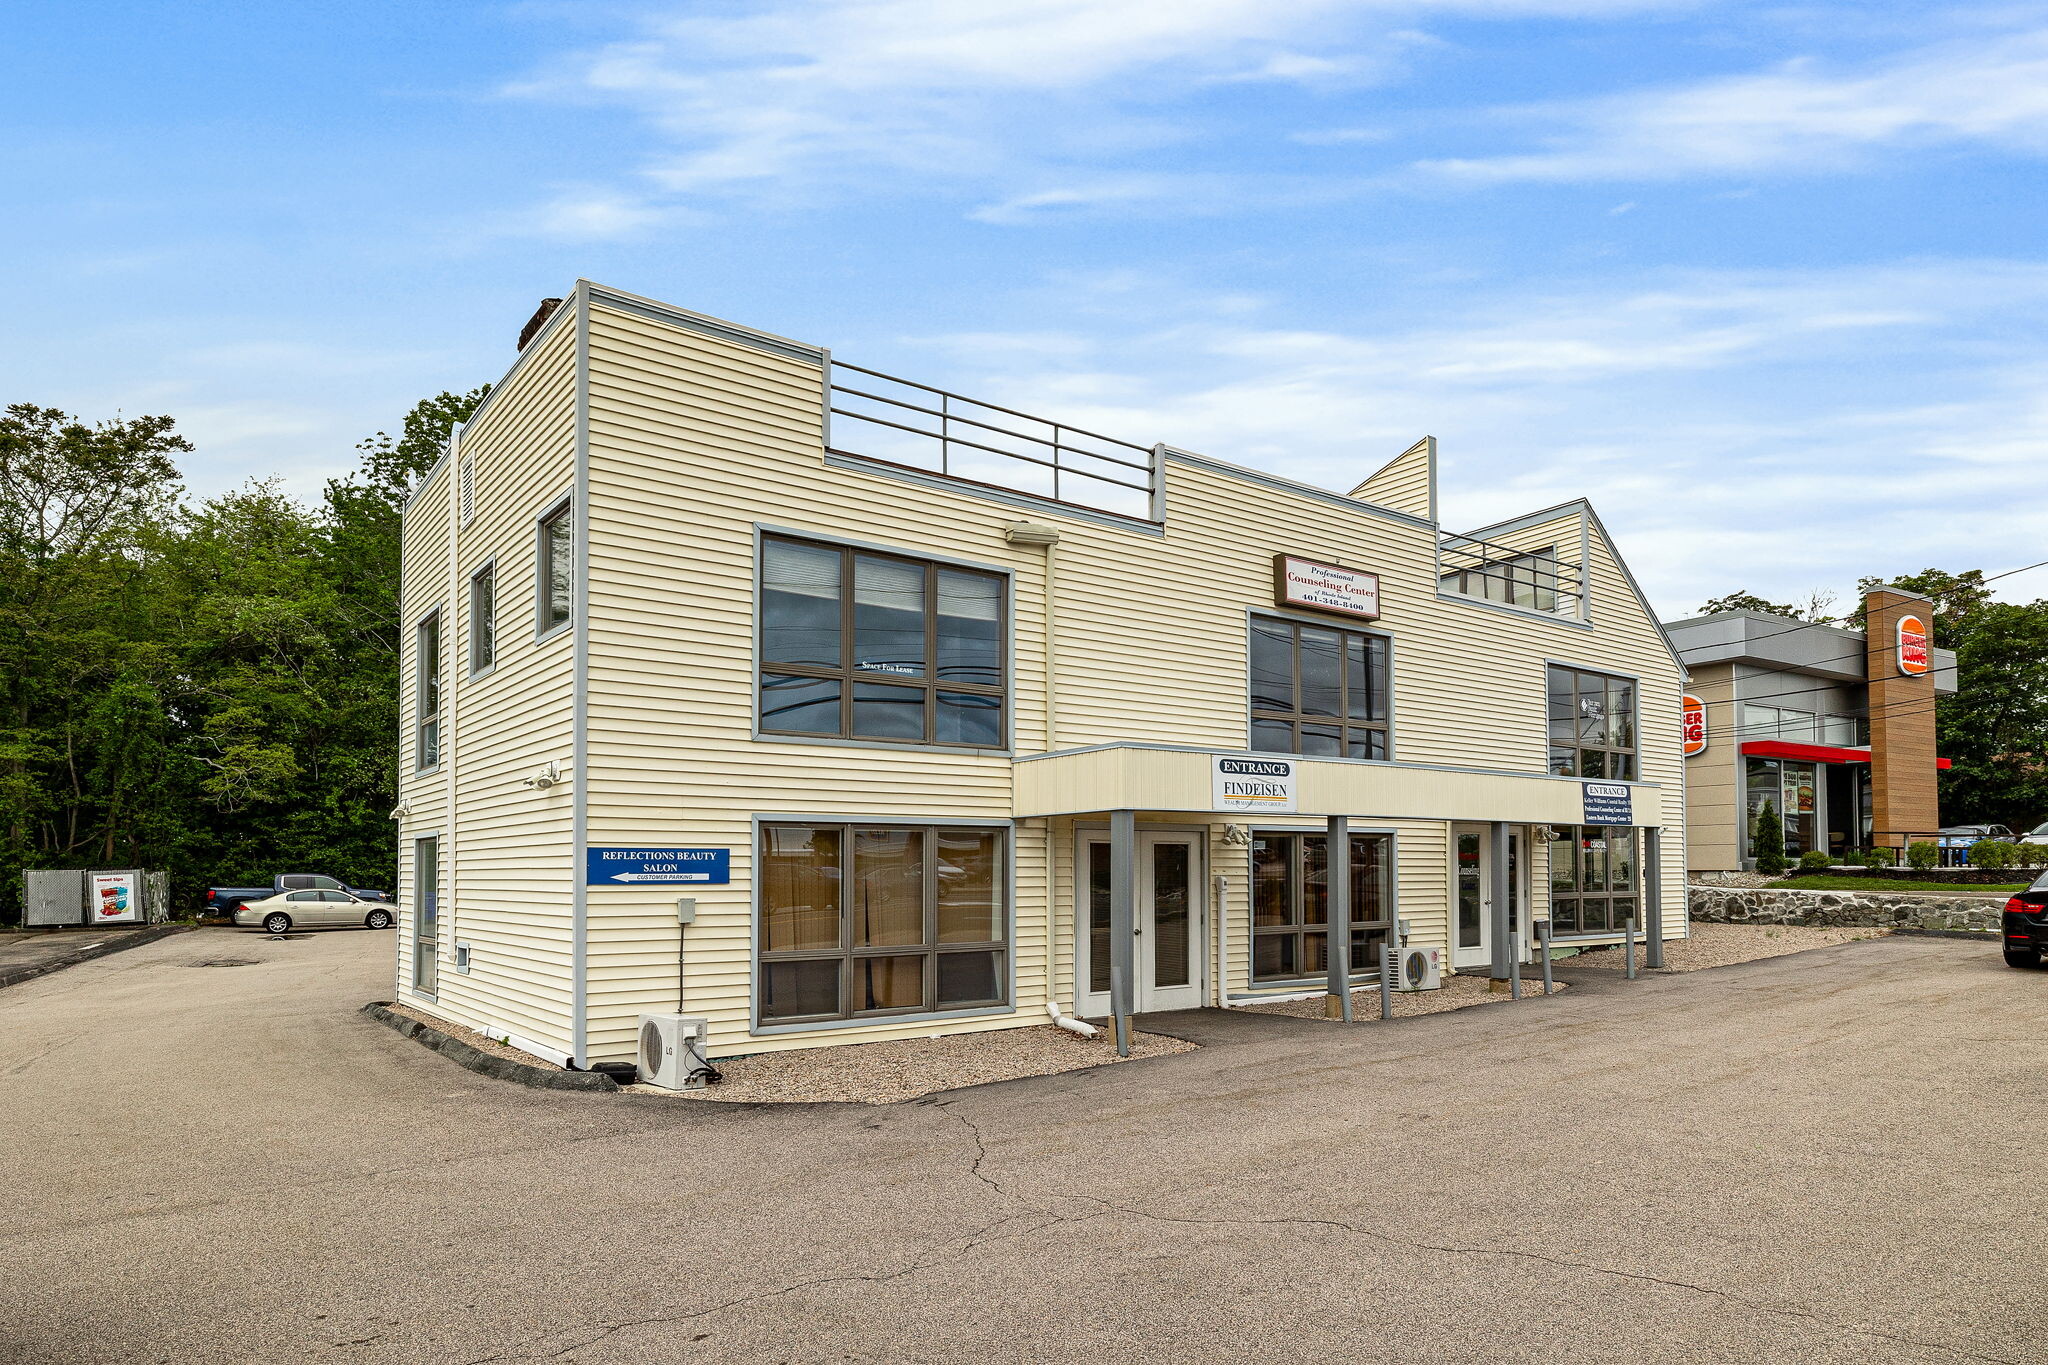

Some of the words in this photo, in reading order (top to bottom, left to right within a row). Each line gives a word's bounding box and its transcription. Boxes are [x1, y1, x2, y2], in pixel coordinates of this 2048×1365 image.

[1311, 566, 1354, 582] Professional
[1288, 571, 1342, 593] Counseling
[1344, 583, 1376, 598] Center
[1302, 593, 1364, 611] 401-348-8400
[1321, 590, 1337, 598] Rhode
[1337, 593, 1352, 601] Island
[1901, 633, 1927, 649] BURGER
[1901, 645, 1927, 665] KING
[1223, 761, 1287, 775] ENTRANCE
[1224, 781, 1287, 796] FINDEISEN
[1589, 786, 1625, 796] ENTRANCE
[602, 851, 675, 861] REFLECTIONS
[677, 851, 717, 861] BEAUTY
[643, 863, 678, 872] SALON
[665, 1046, 673, 1056] LG
